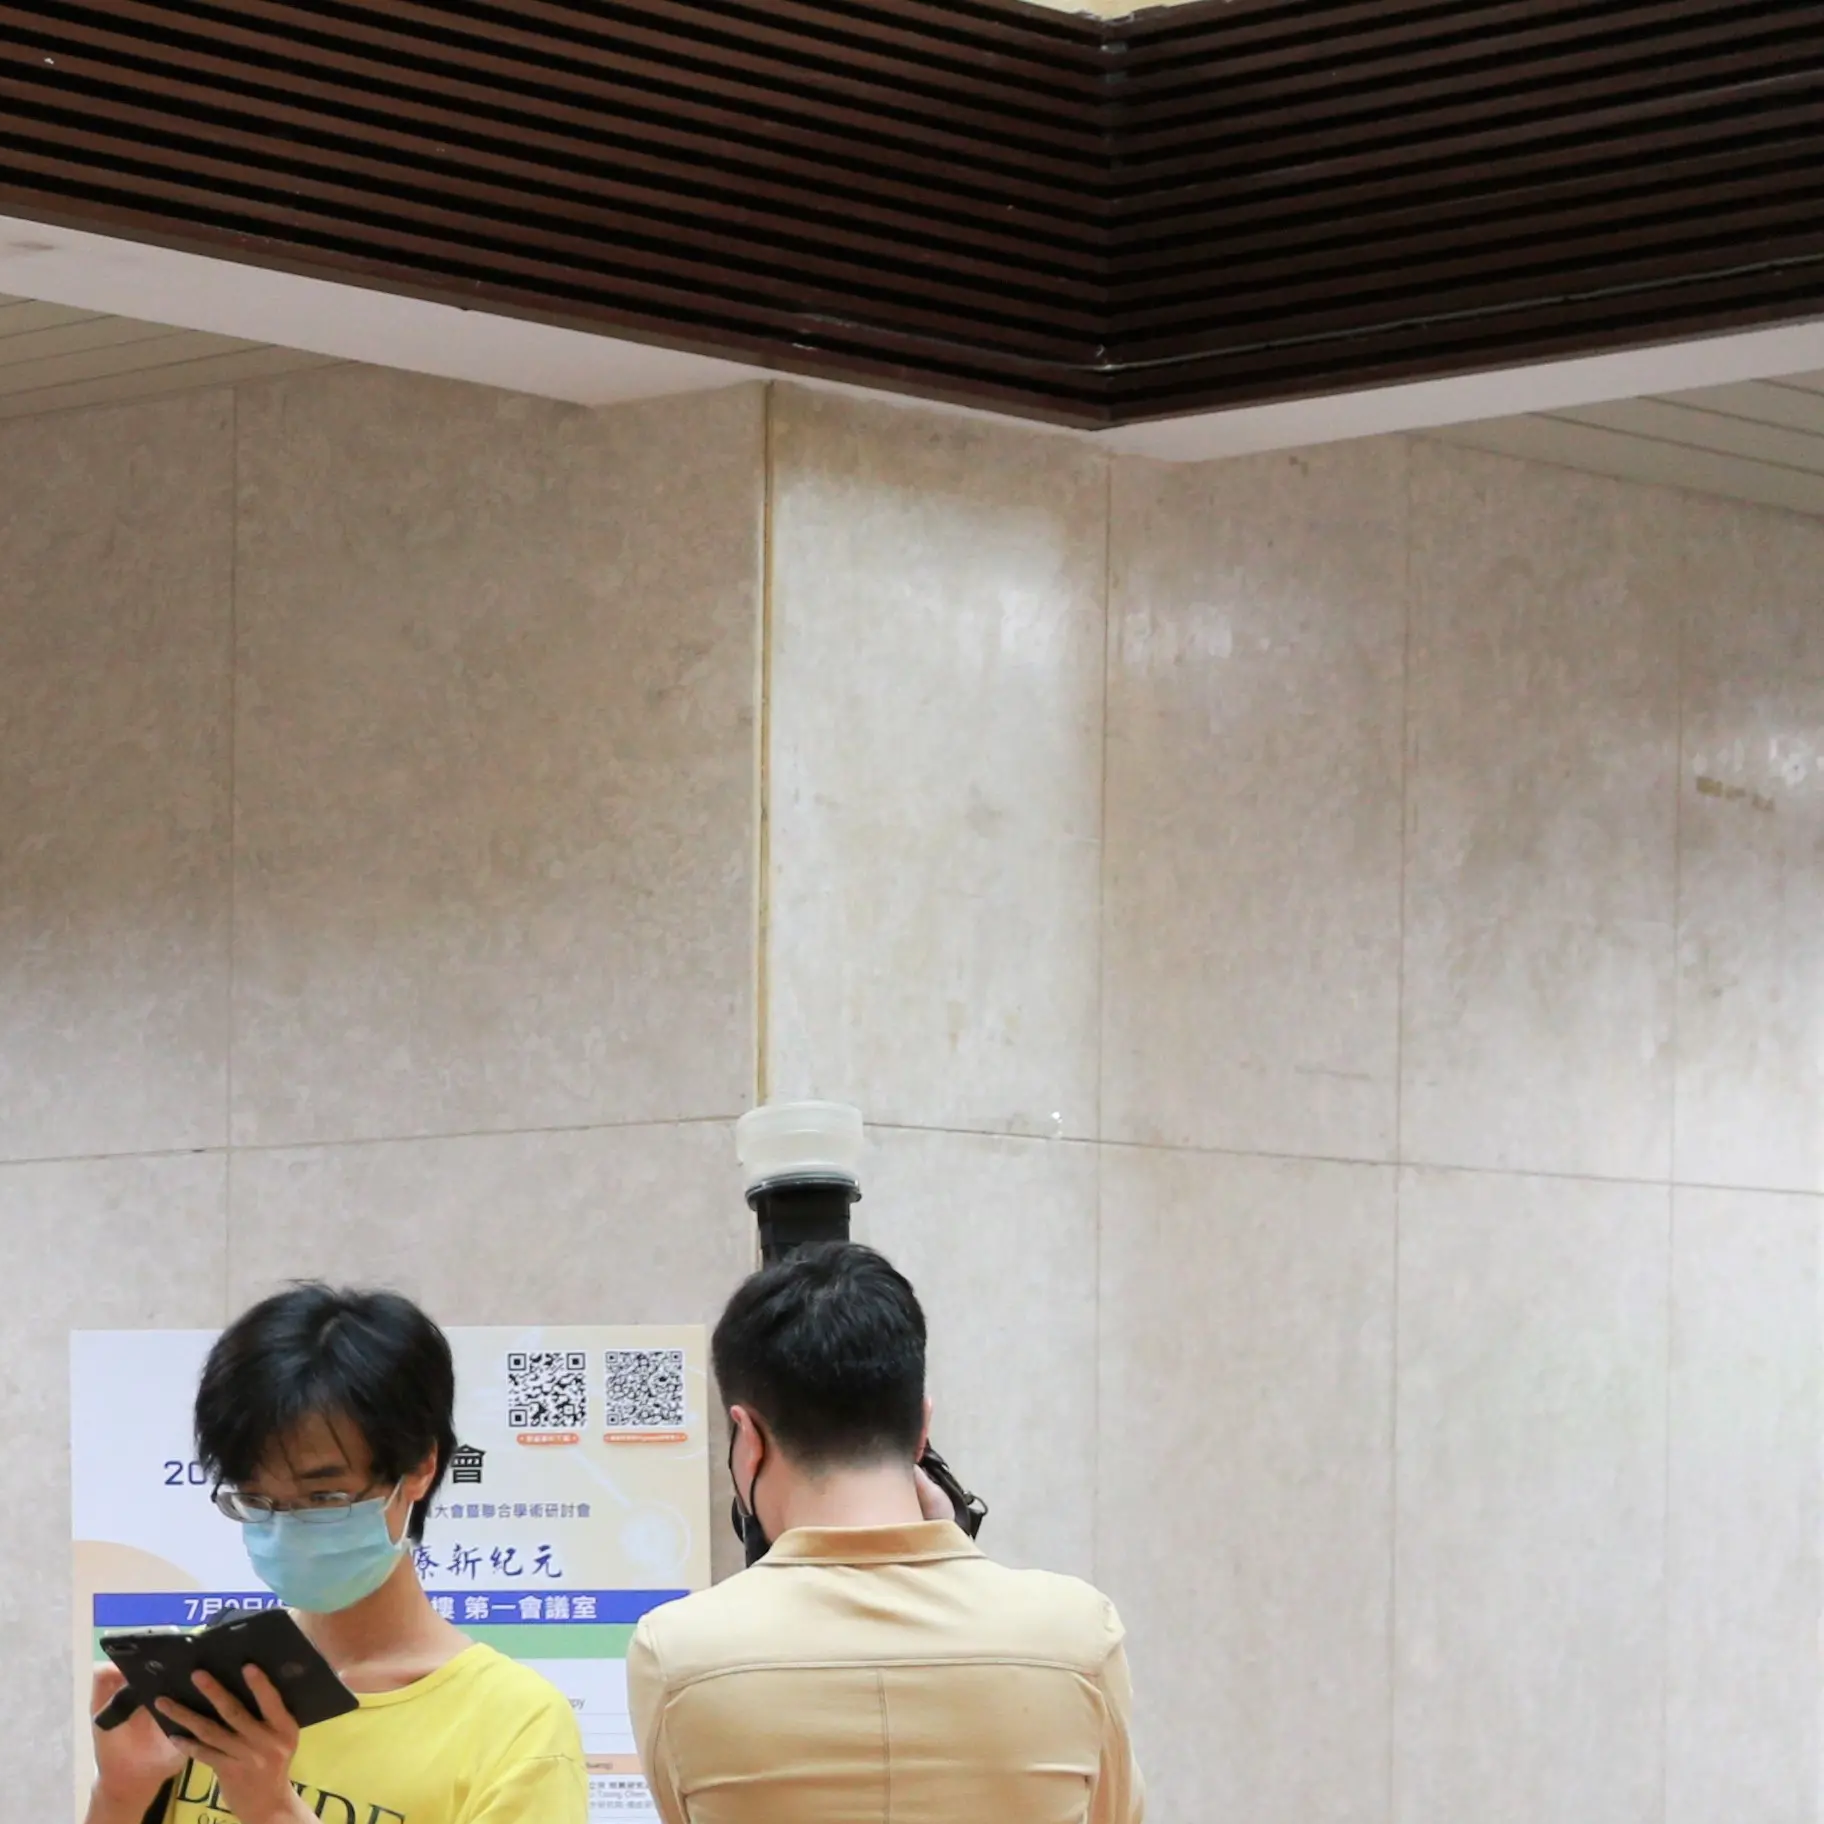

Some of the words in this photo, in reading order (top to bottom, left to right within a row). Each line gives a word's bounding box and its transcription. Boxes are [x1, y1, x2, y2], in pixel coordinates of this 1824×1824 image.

[426, 1503, 591, 1519] 大會暨聯合學術研討會
[464, 1595, 597, 1620] 第一會議室
